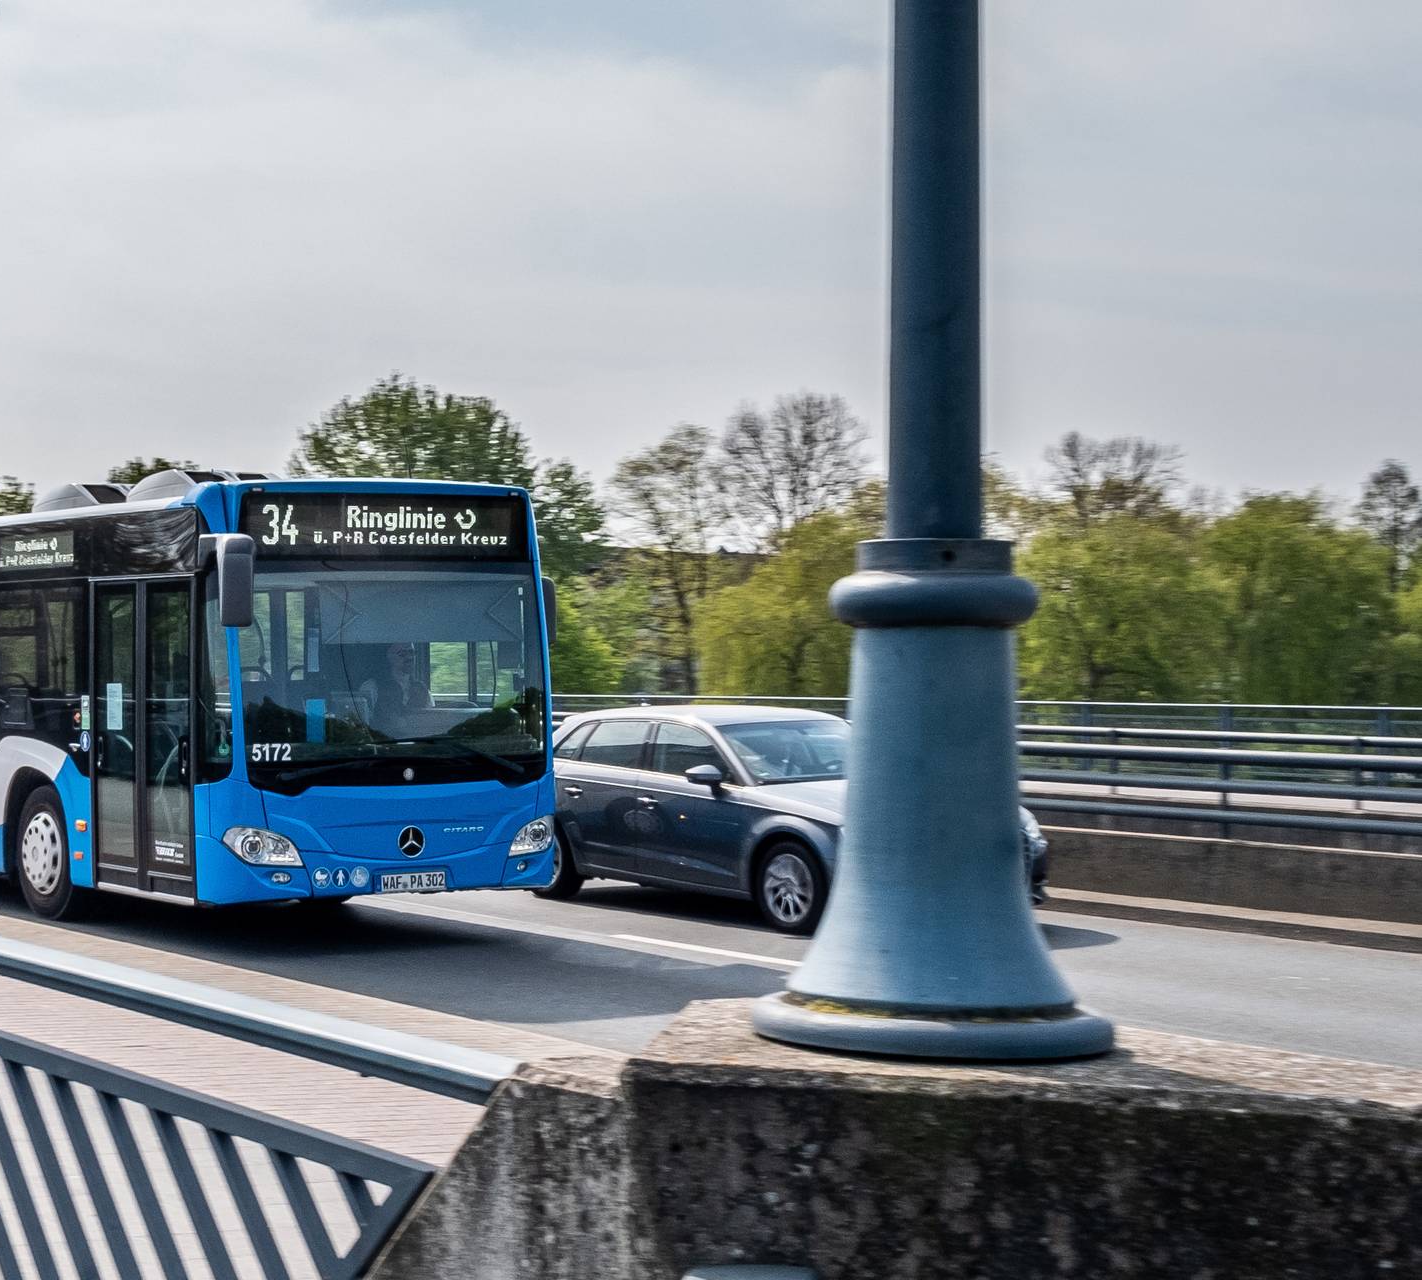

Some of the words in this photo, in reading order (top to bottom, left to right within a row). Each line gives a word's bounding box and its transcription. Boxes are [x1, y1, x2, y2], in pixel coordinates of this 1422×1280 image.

[262, 504, 299, 545] 34
[347, 505, 446, 532] Ringlinie
[333, 531, 364, 545] P+R
[368, 531, 456, 545] Coesfelder
[461, 532, 508, 545] Kreuz
[252, 743, 291, 762] 5172
[382, 875, 402, 889] WAF
[410, 875, 423, 888] PA
[425, 873, 445, 887] 302
